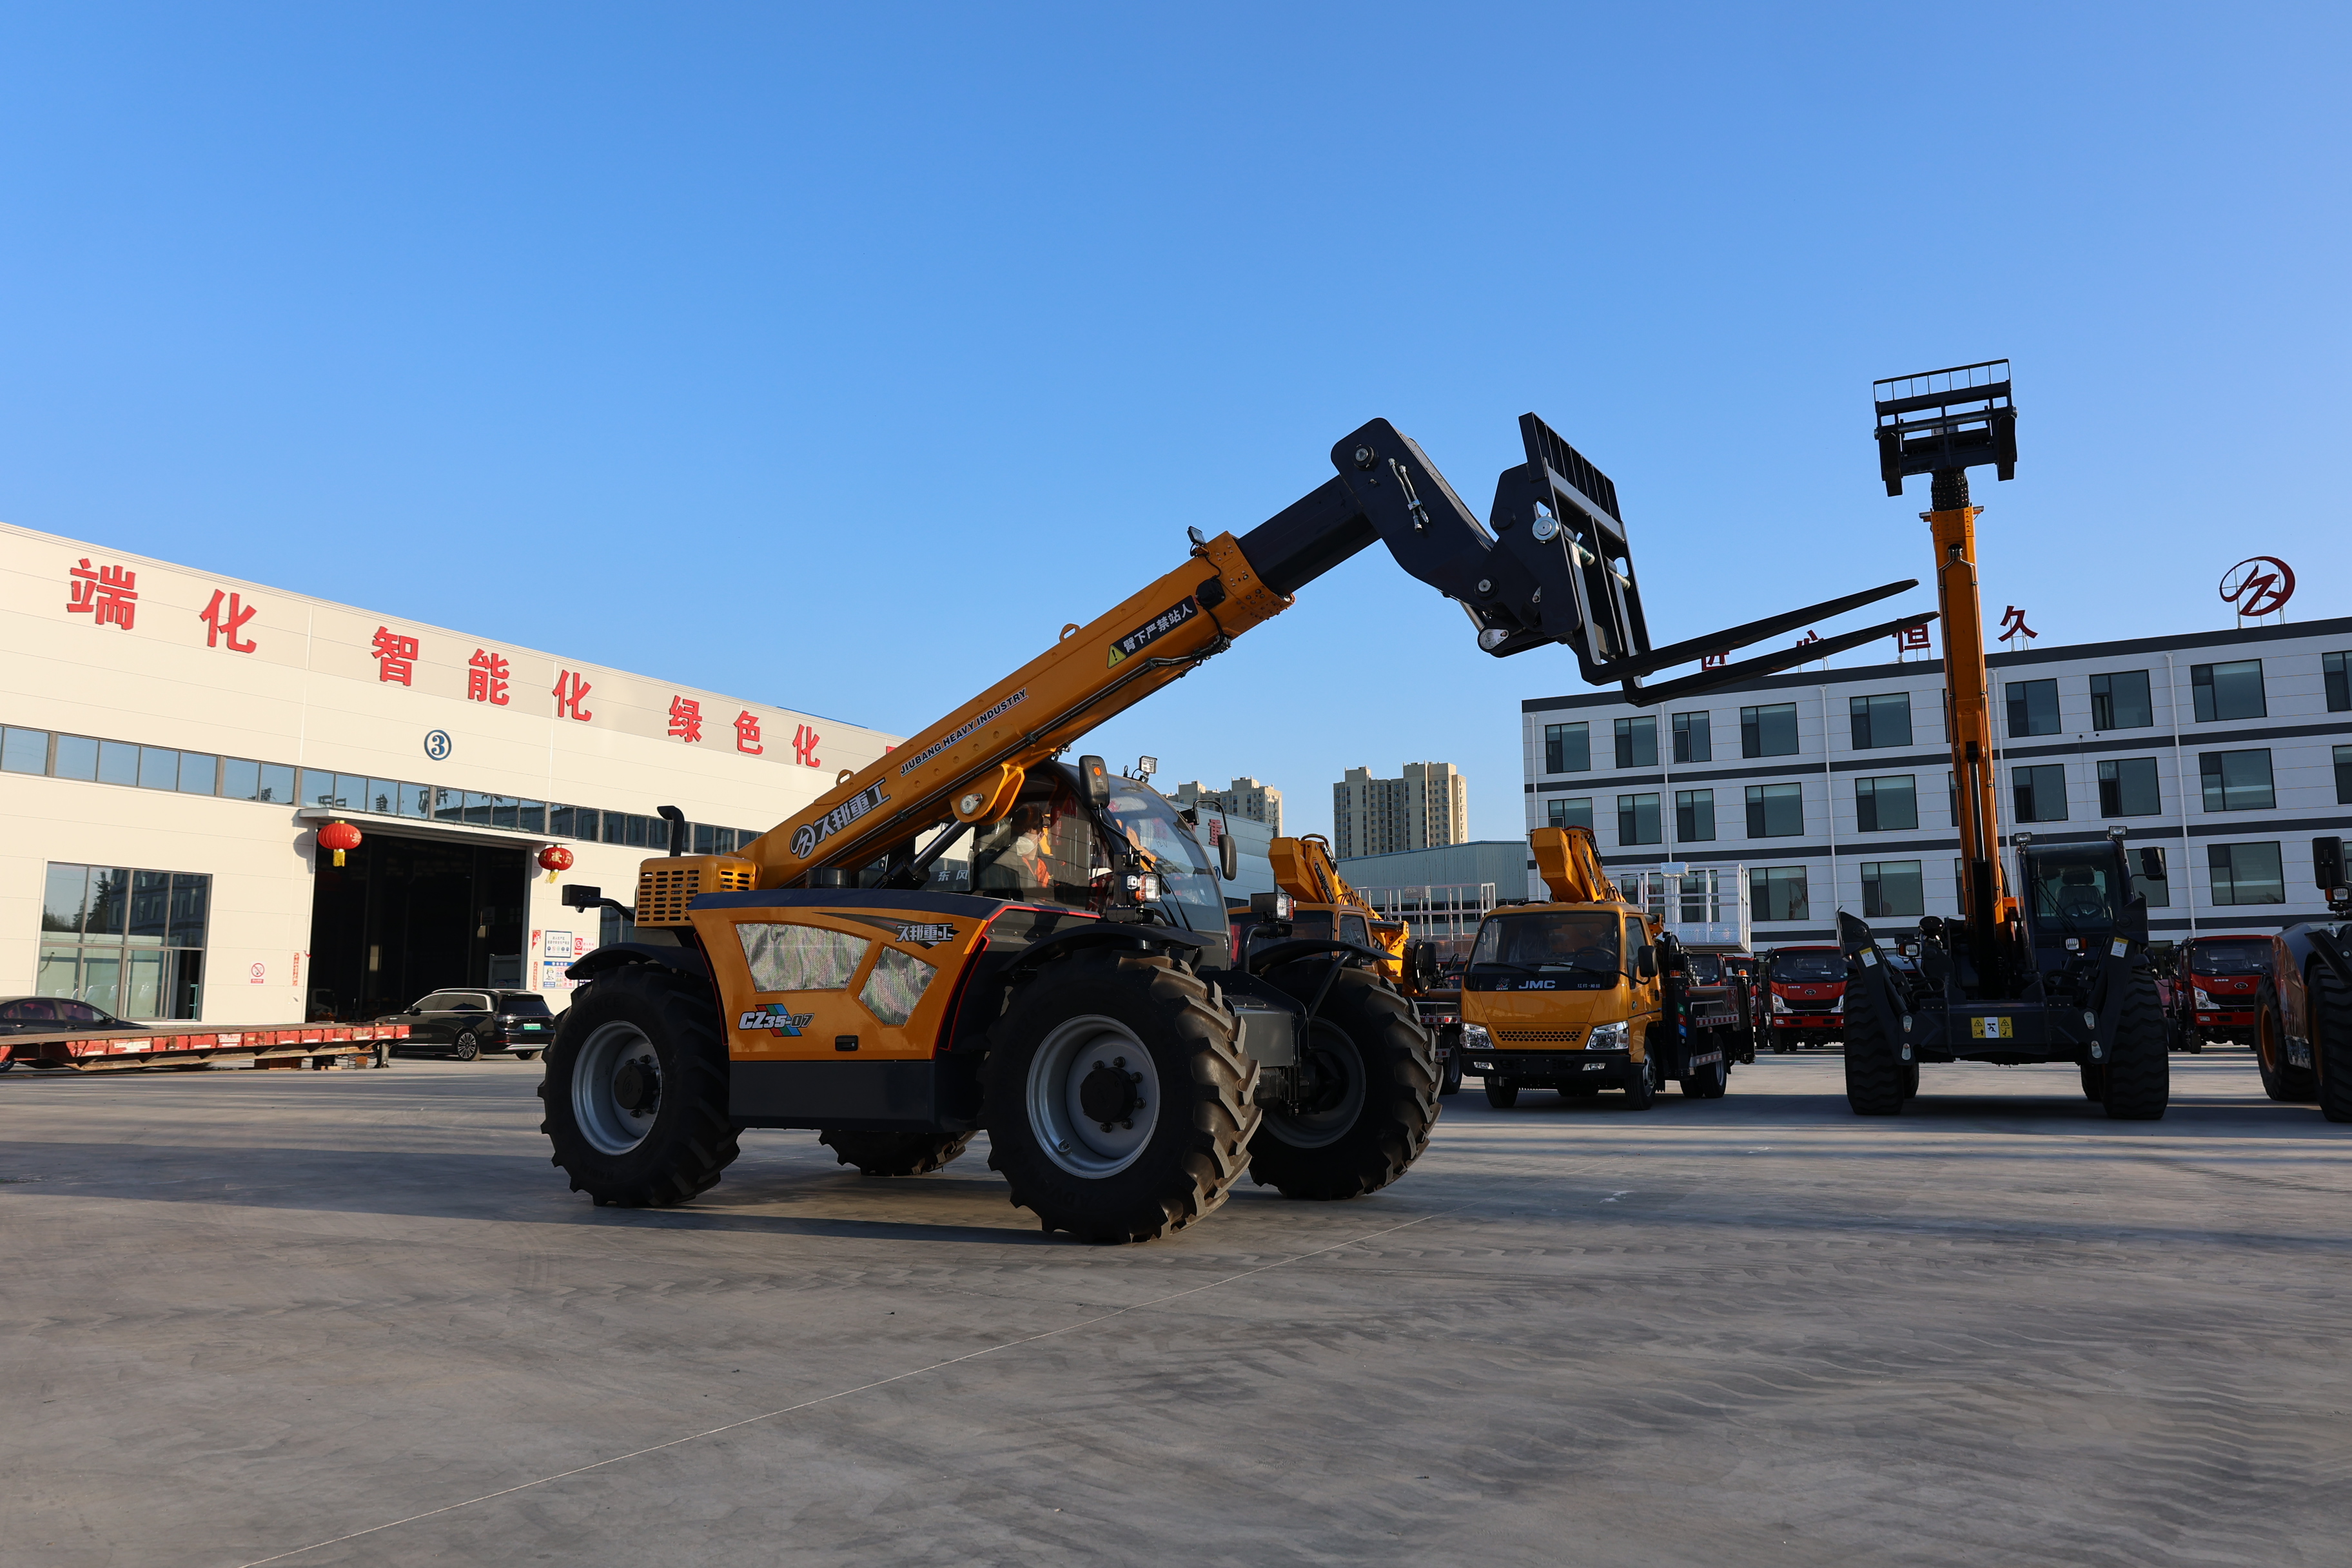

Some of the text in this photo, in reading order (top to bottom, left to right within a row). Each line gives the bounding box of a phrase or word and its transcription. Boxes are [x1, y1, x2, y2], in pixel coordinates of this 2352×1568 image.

[1123, 603, 1193, 652] 臂下严禁站人
[900, 688, 1027, 775] JIUBANG HEAVY INDUSTRY
[814, 778, 891, 843] 久邦重工
[896, 924, 952, 941] 久邦重工
[1518, 980, 1556, 989] JMC
[738, 1011, 814, 1030] CZ35-07
